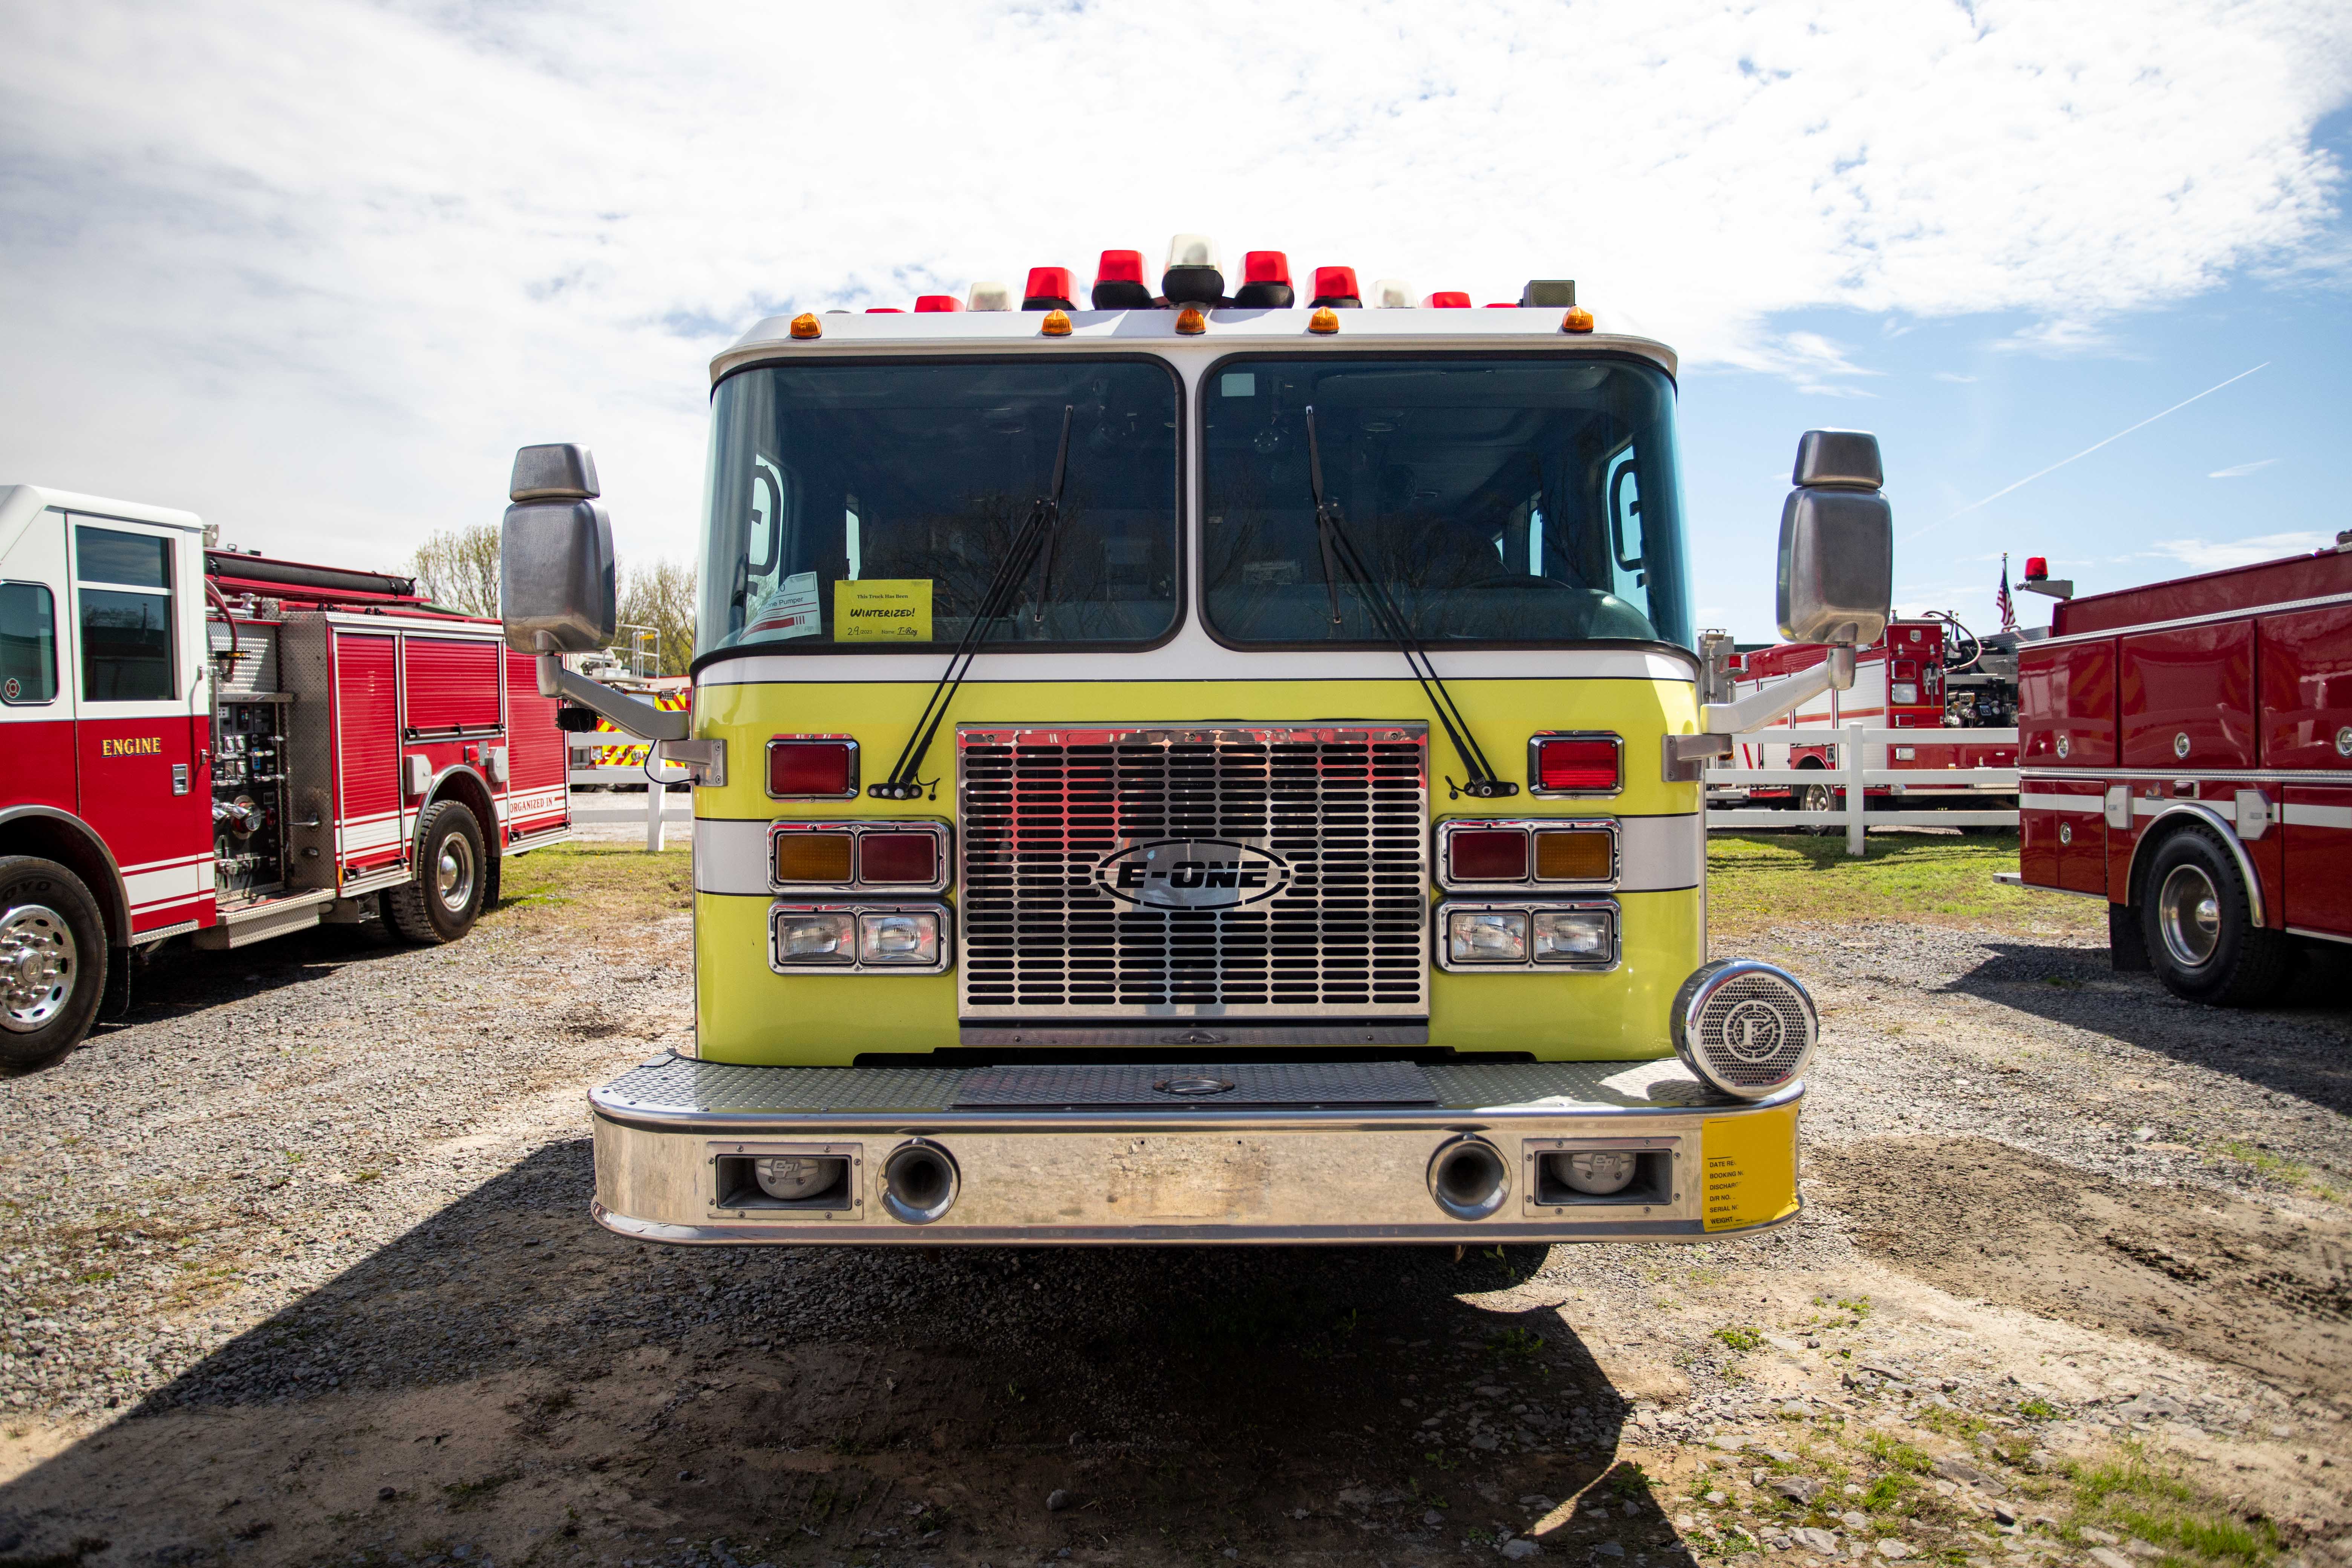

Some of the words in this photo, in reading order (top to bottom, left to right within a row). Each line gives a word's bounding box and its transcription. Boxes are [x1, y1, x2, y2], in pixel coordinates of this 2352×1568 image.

[779, 597, 804, 606] Pumper
[850, 607, 915, 617] WINTERIZED!
[897, 627, 918, 637] T-Roy
[101, 737, 162, 758] ENGINE
[510, 798, 544, 813] ORGANIZED
[547, 797, 553, 806] IN
[1116, 861, 1270, 888] E-ONE
